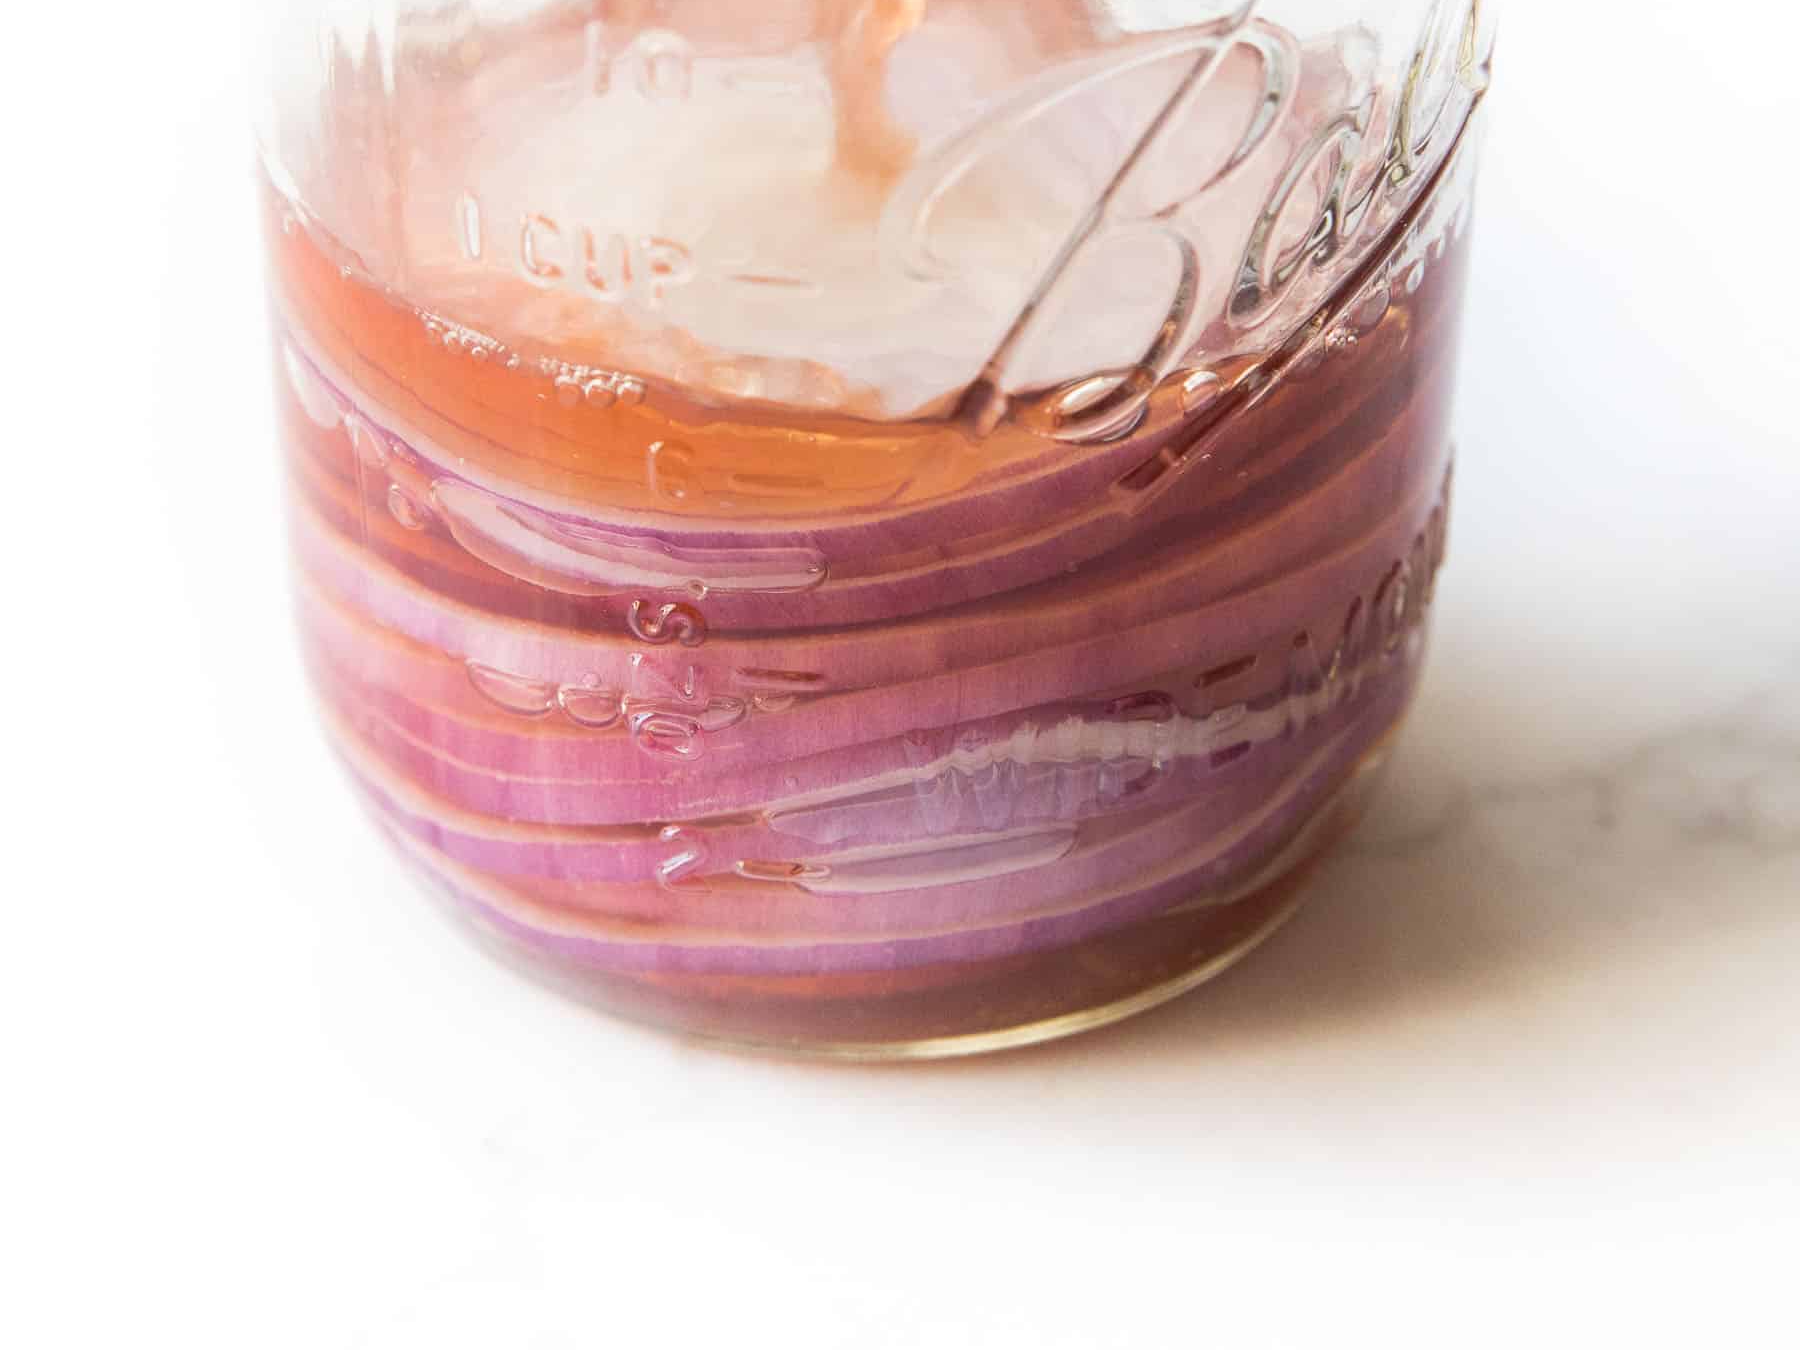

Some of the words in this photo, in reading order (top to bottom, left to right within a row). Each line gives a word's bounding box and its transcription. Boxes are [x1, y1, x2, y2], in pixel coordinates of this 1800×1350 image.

[583, 18, 695, 102] 10
[456, 188, 482, 260] 1
[518, 208, 698, 310] CUP
